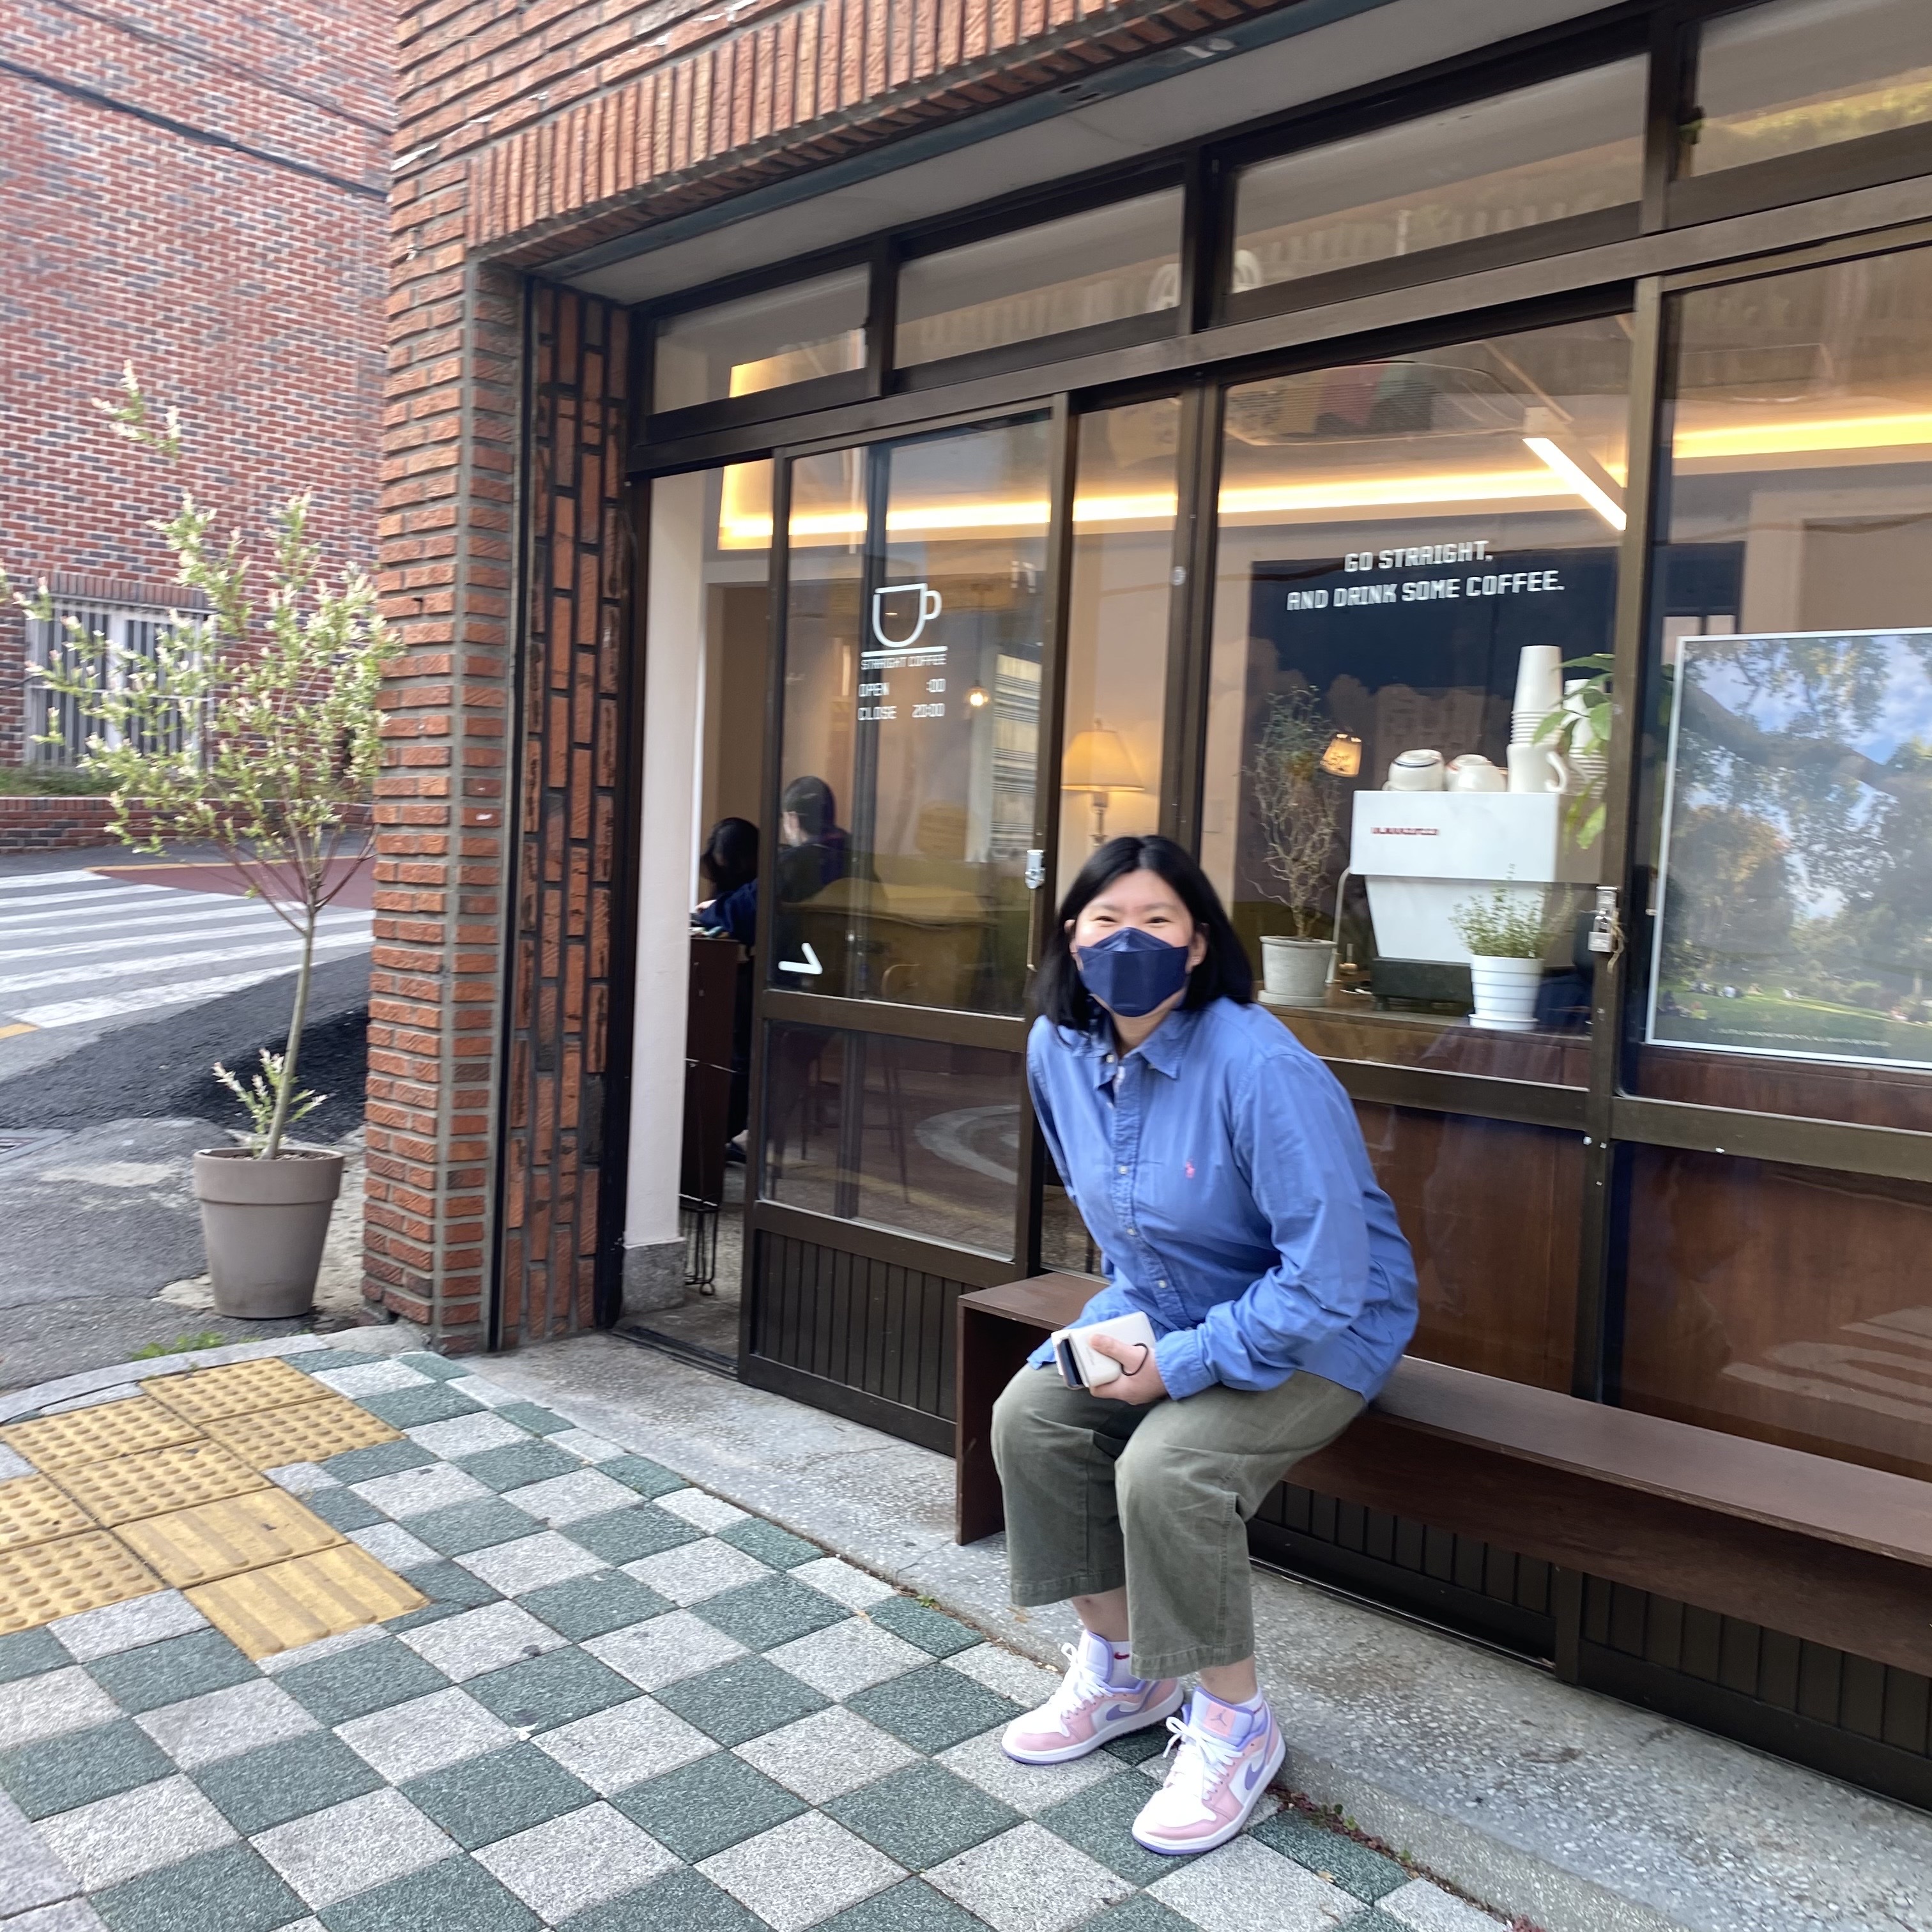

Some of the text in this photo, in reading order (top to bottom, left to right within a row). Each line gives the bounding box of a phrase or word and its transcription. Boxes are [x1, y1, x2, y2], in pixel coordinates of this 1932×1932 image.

[1345, 552, 1373, 572] GO
[1287, 570, 1565, 611] AND DRINK SOME COFFEE.
[858, 705, 897, 720] CLOSE
